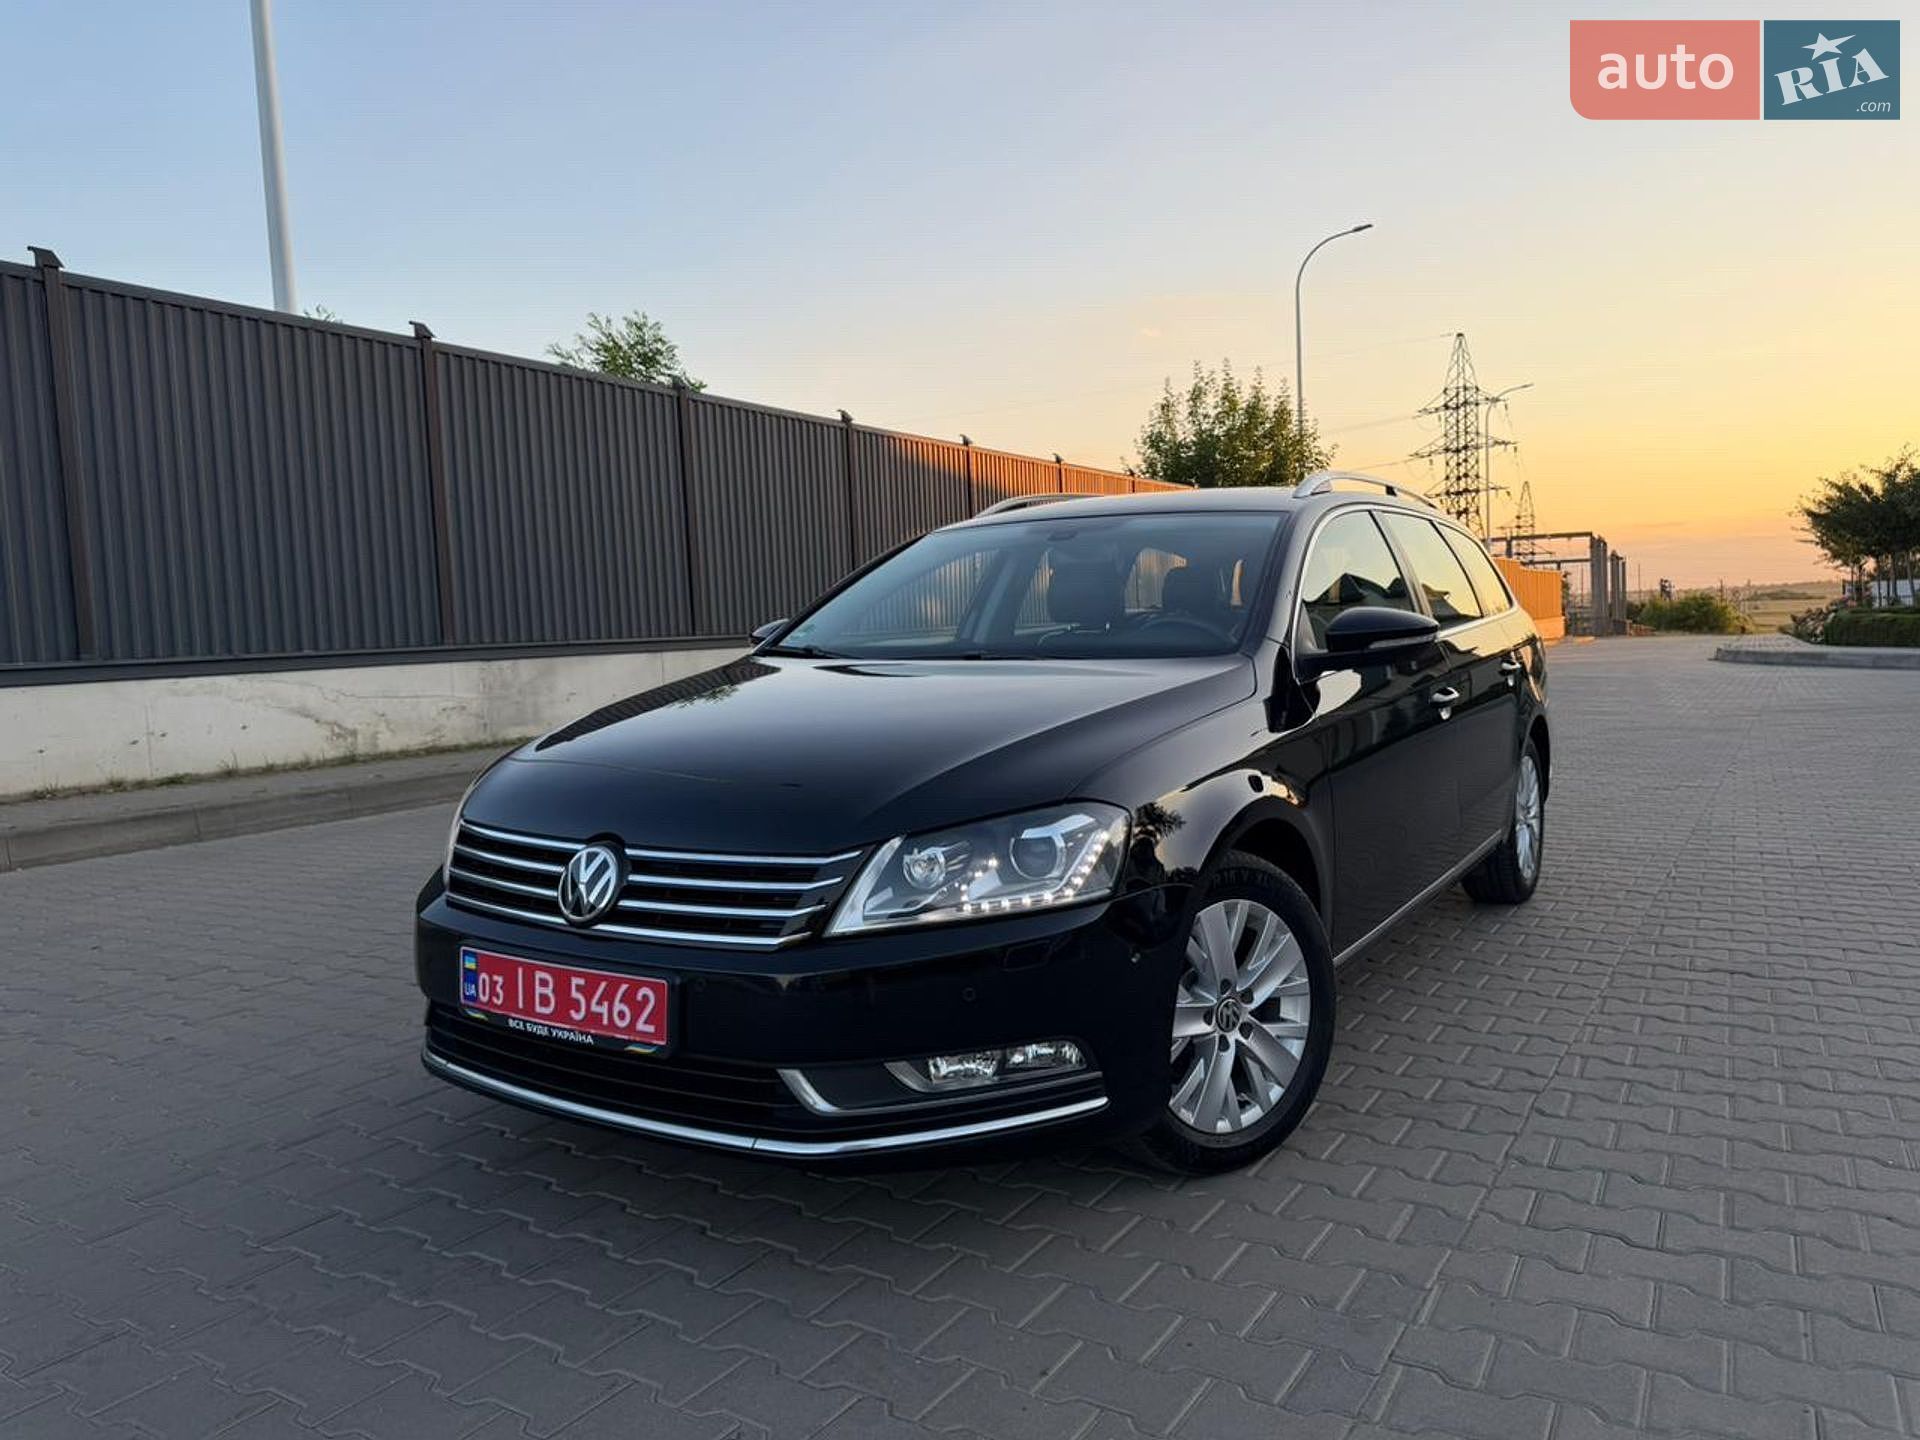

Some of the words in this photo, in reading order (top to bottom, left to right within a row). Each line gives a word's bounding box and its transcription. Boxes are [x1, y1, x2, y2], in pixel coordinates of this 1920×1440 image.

[464, 982, 477, 997] UA
[478, 972, 504, 1005] 03
[569, 976, 656, 1033] 5462
